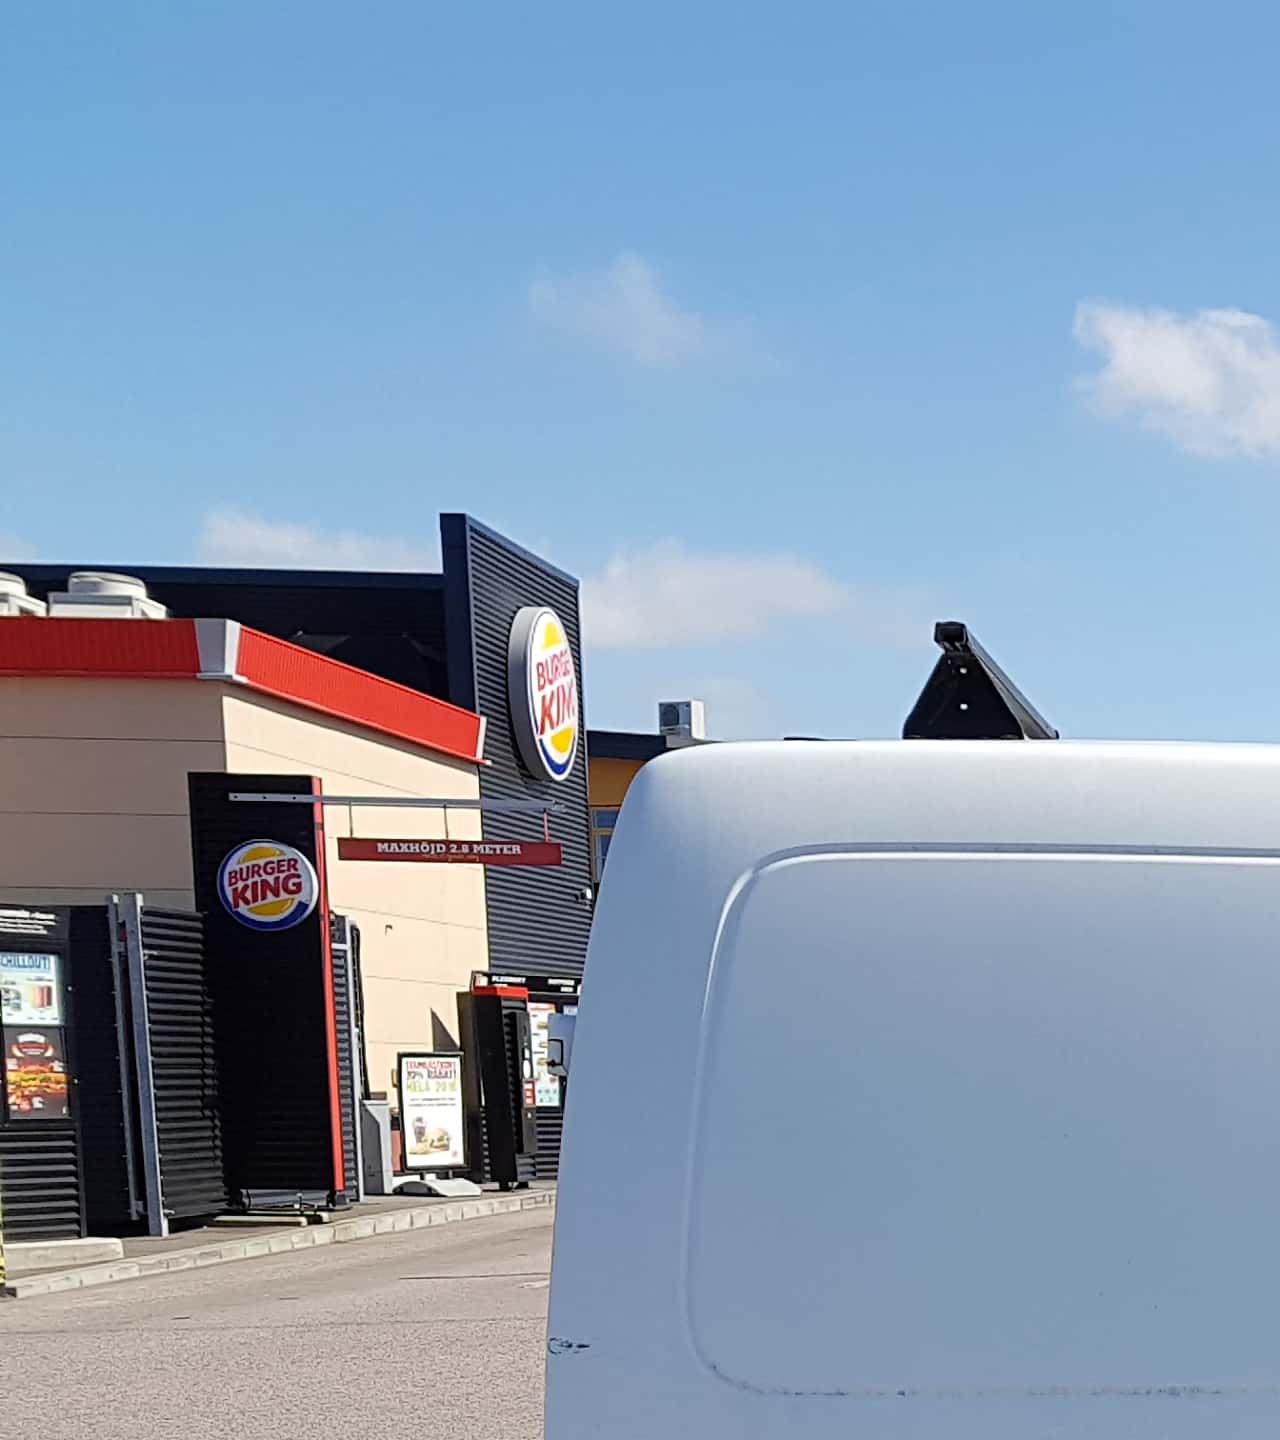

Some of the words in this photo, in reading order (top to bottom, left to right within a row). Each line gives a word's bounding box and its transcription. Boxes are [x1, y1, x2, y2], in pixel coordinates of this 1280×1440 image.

[536, 649, 571, 691] BURG
[538, 679, 576, 736] KIN
[376, 842, 446, 855] MAXHÖJD
[473, 844, 522, 855] METER
[228, 857, 299, 887] BURGER
[230, 873, 303, 909] KING
